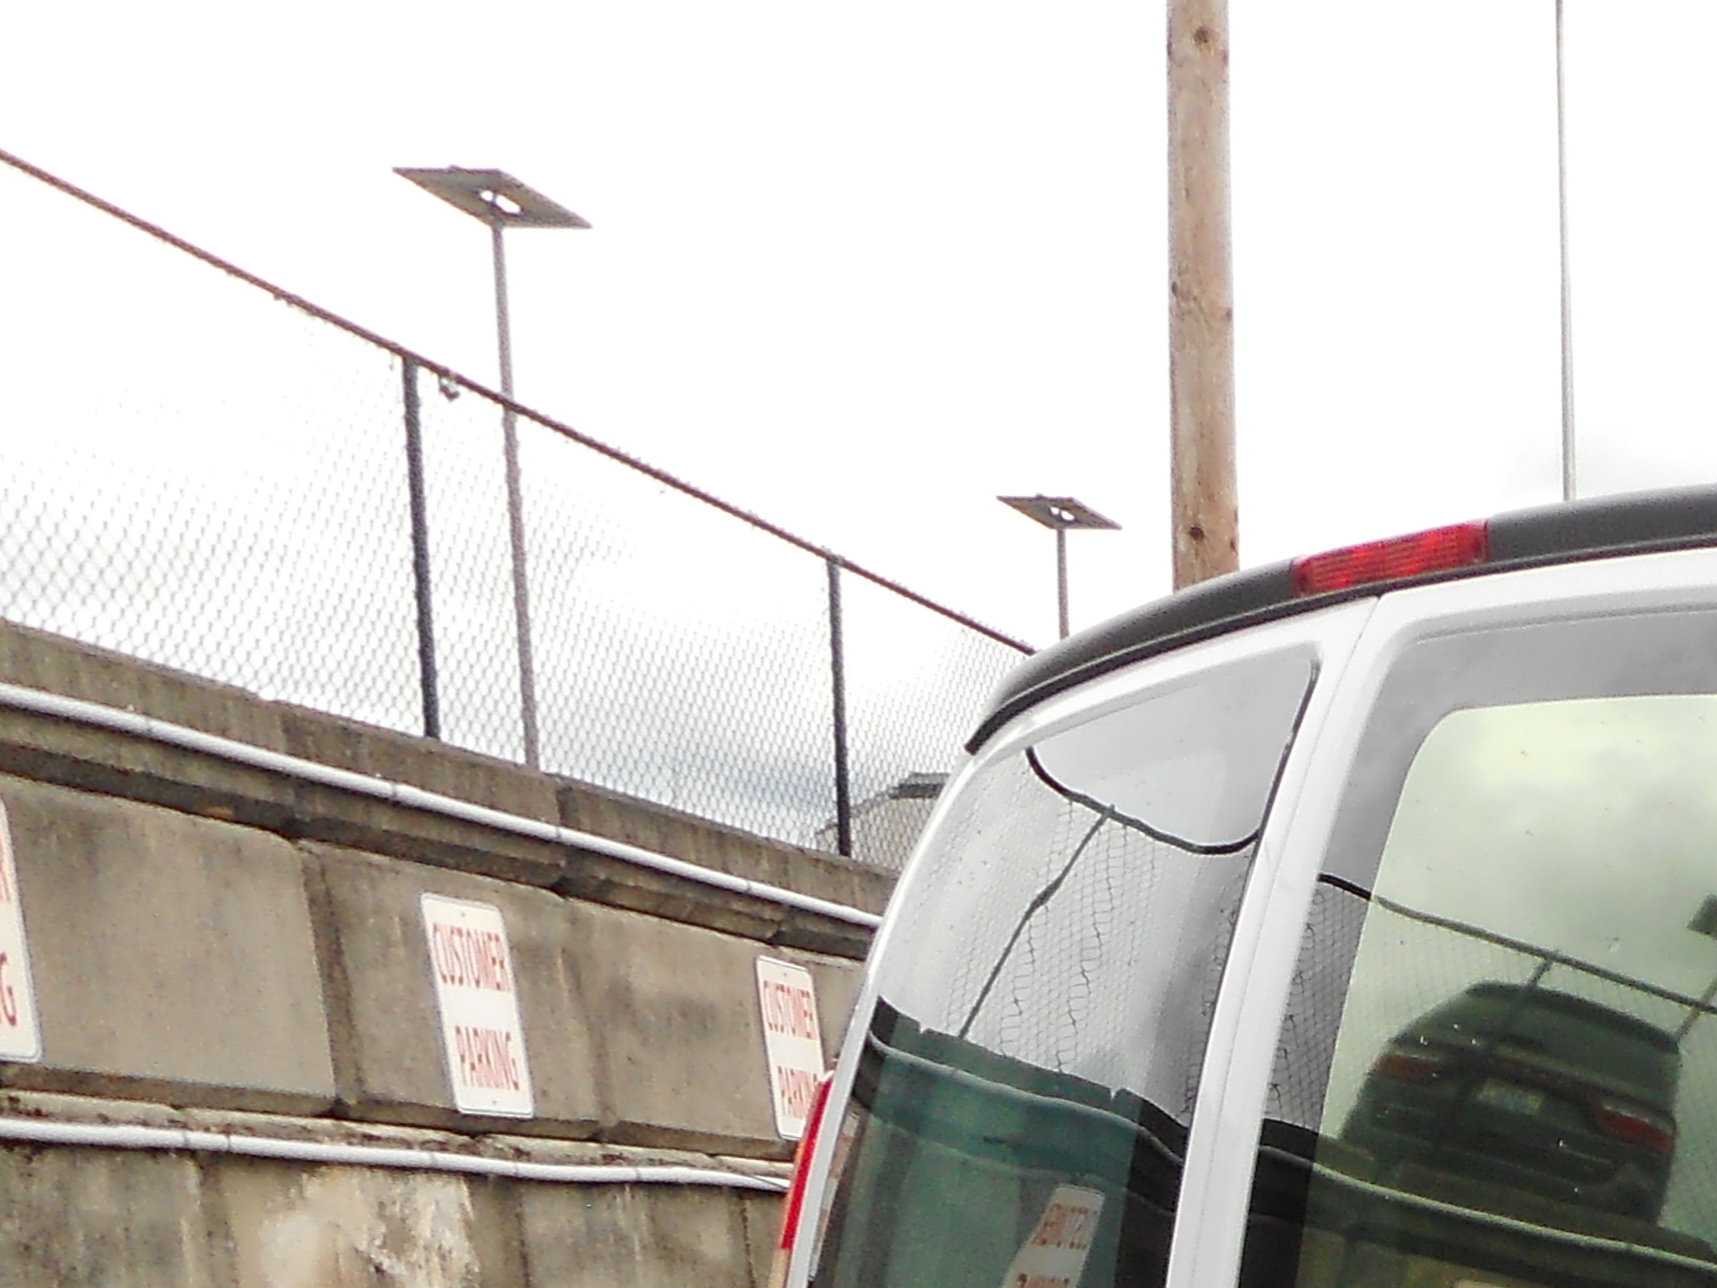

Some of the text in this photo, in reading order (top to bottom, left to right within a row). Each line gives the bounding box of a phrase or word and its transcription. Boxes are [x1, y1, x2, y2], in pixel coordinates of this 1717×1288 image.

[433, 923, 513, 993] CUSTOMER
[763, 979, 818, 1040] CUSTOMER
[455, 1025, 520, 1091] PARKING
